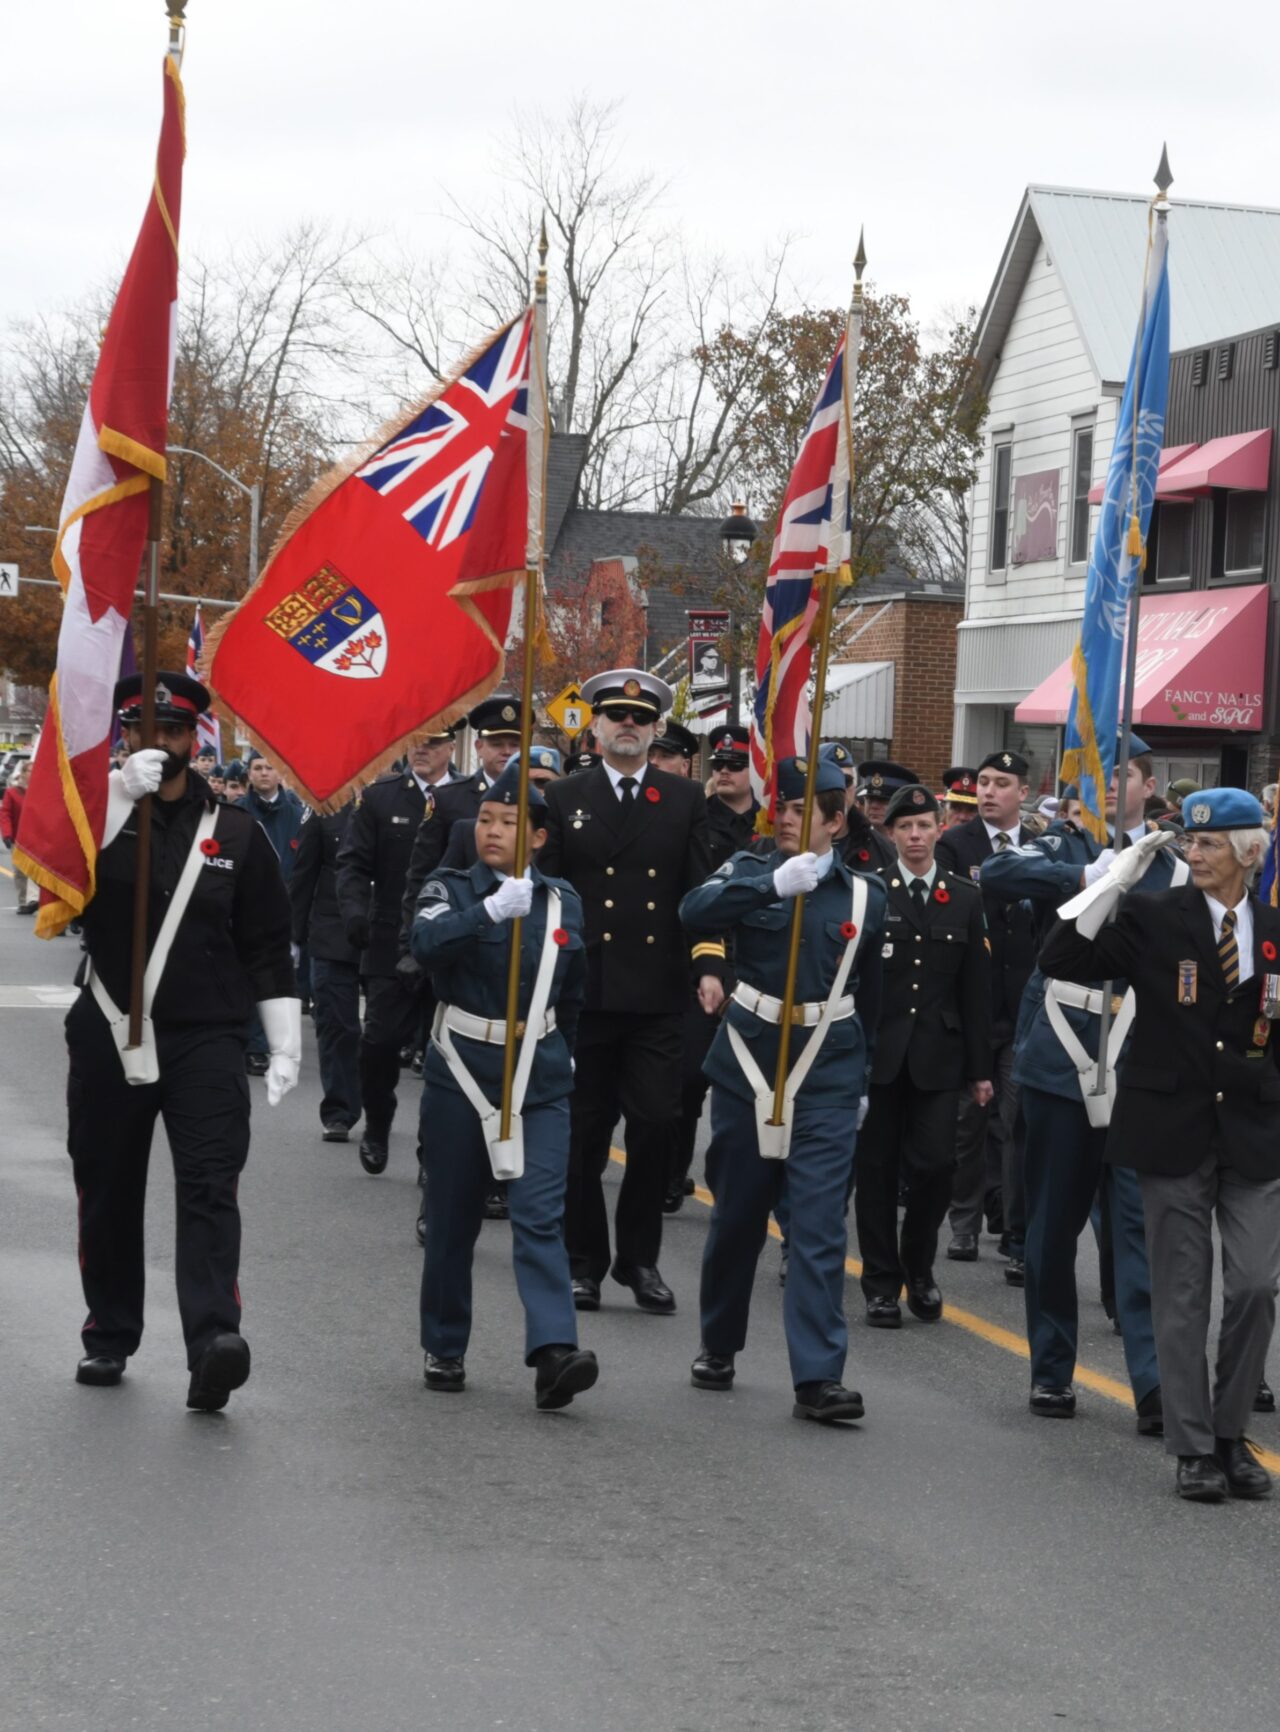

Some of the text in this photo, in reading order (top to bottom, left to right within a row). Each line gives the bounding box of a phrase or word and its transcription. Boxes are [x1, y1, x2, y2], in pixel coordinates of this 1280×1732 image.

[1165, 689, 1213, 704] FANCY
[1188, 706, 1254, 725] and SPA
[205, 857, 234, 870] LICE
